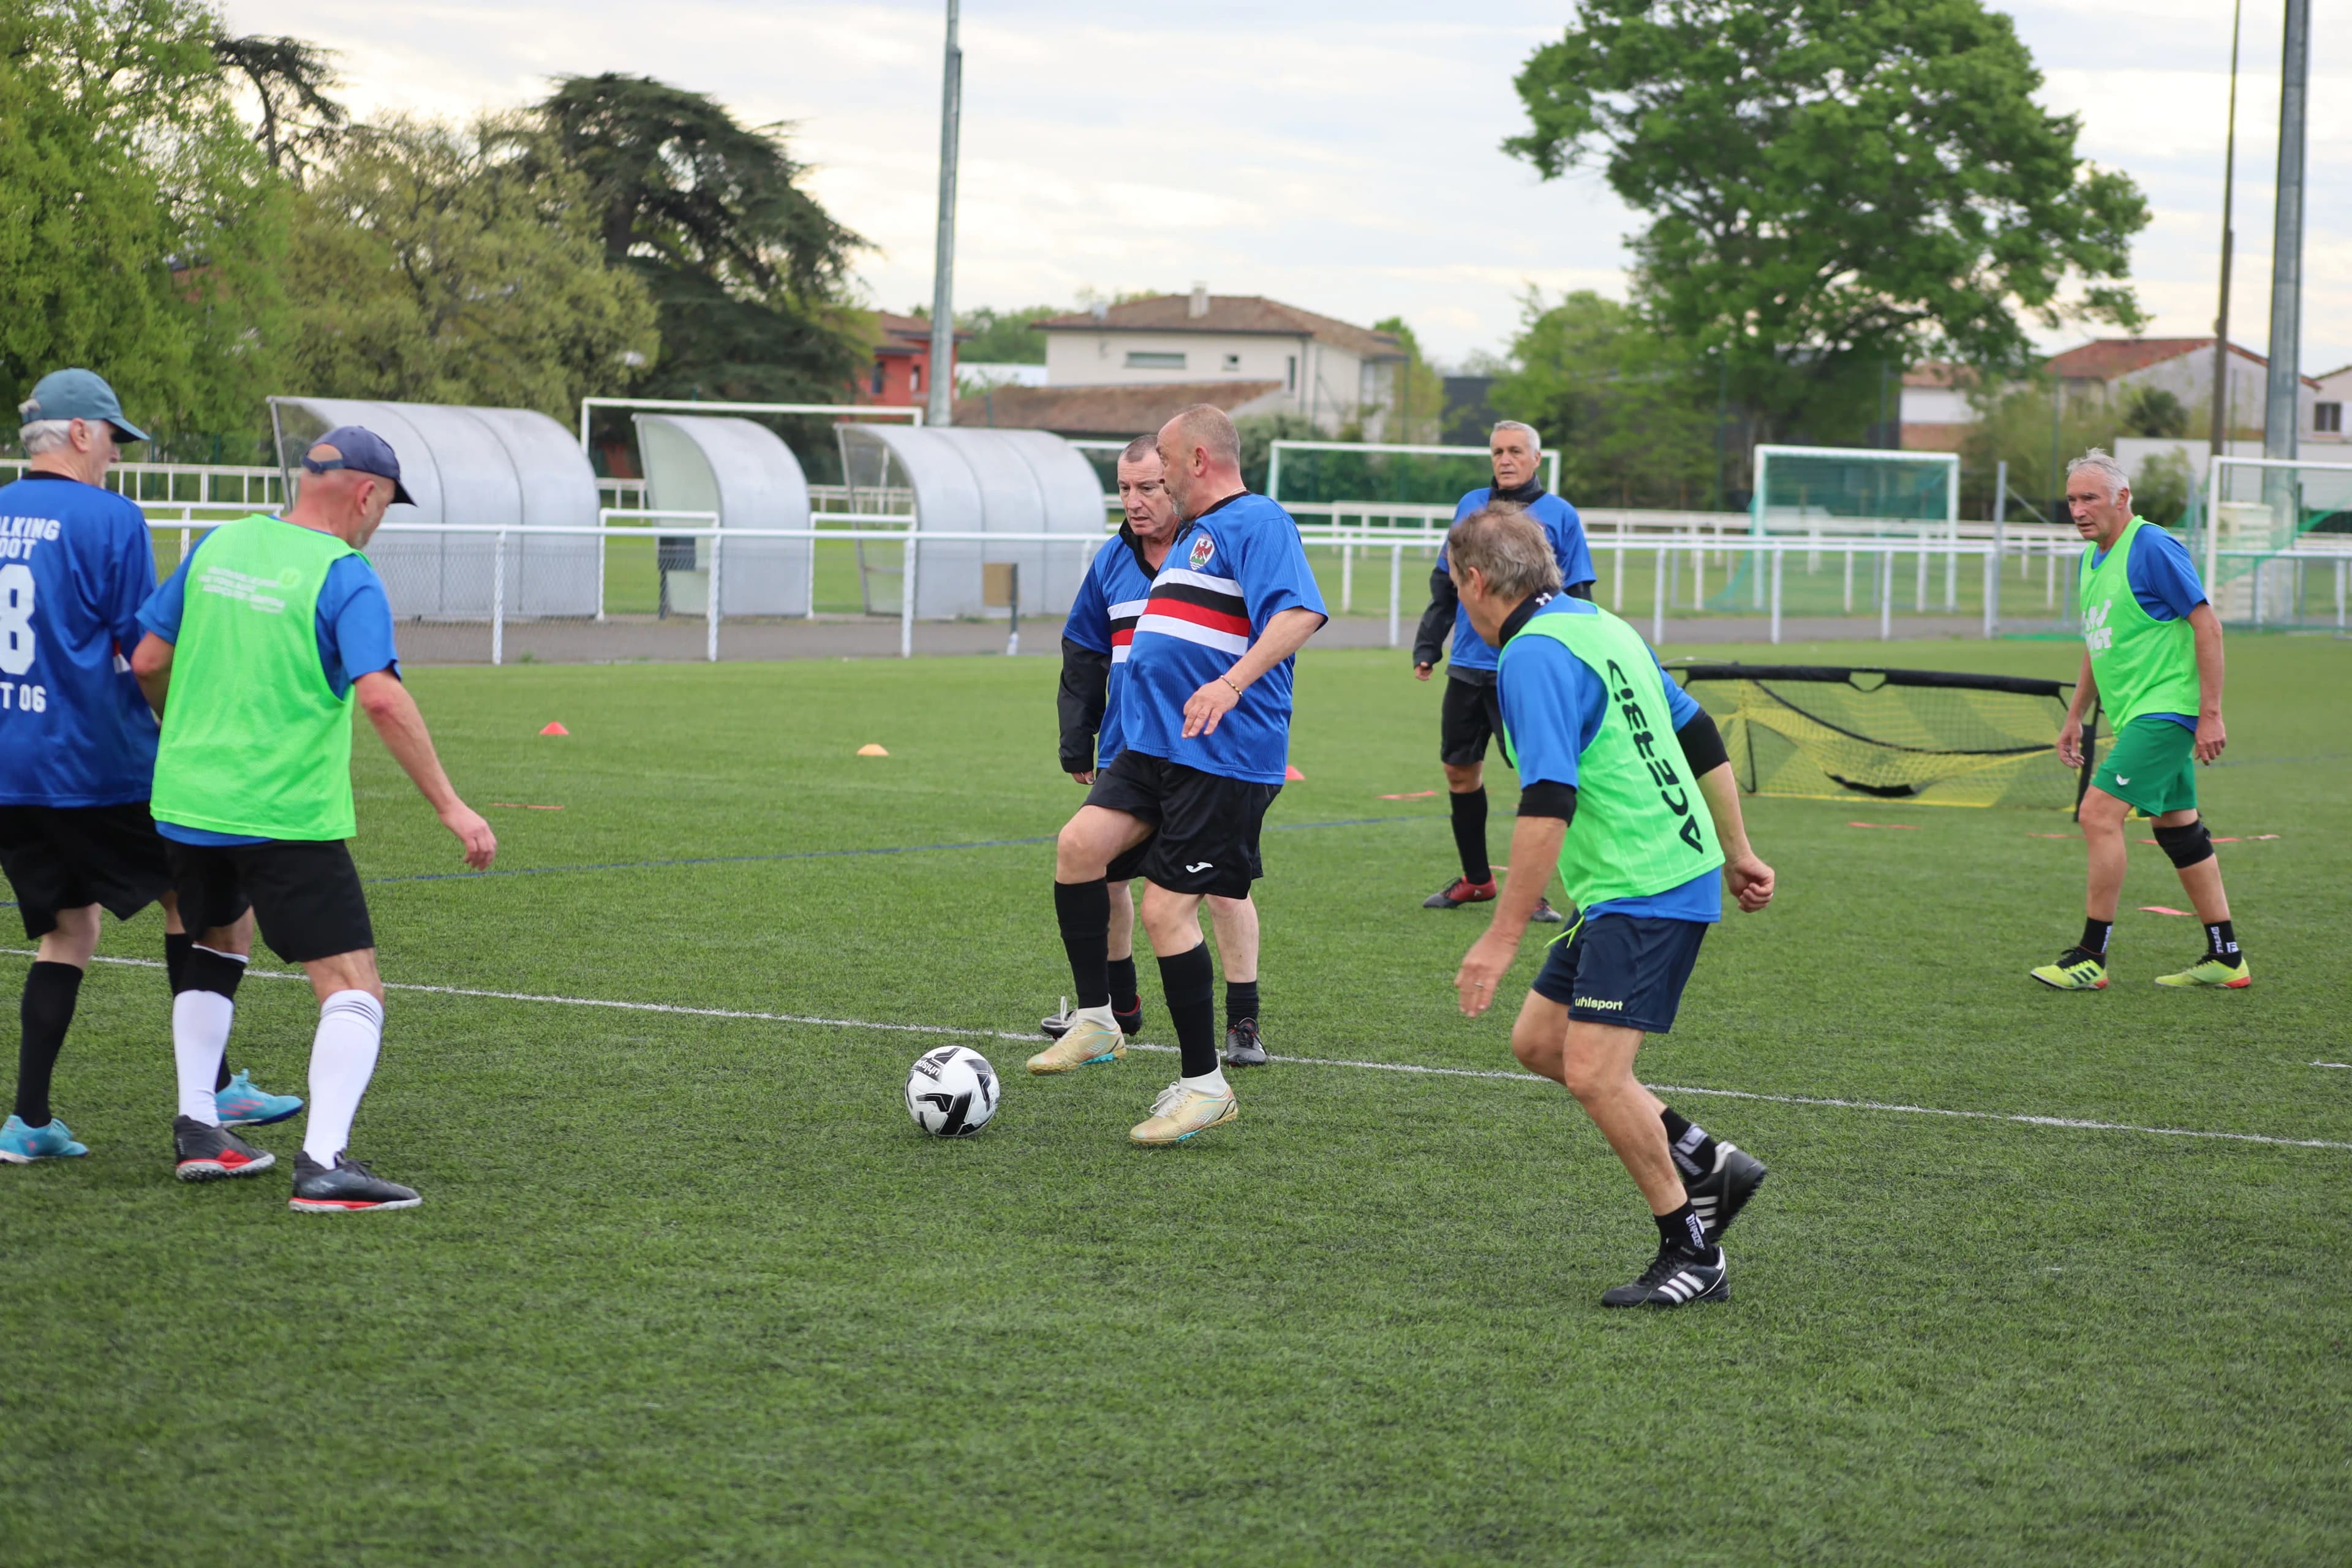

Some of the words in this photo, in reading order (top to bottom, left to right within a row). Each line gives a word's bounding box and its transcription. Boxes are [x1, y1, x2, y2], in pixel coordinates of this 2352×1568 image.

[0, 515, 61, 541] LKING
[0, 564, 36, 676] 8
[19, 684, 47, 713] 06
[1574, 996, 1623, 1011] uhlsport
